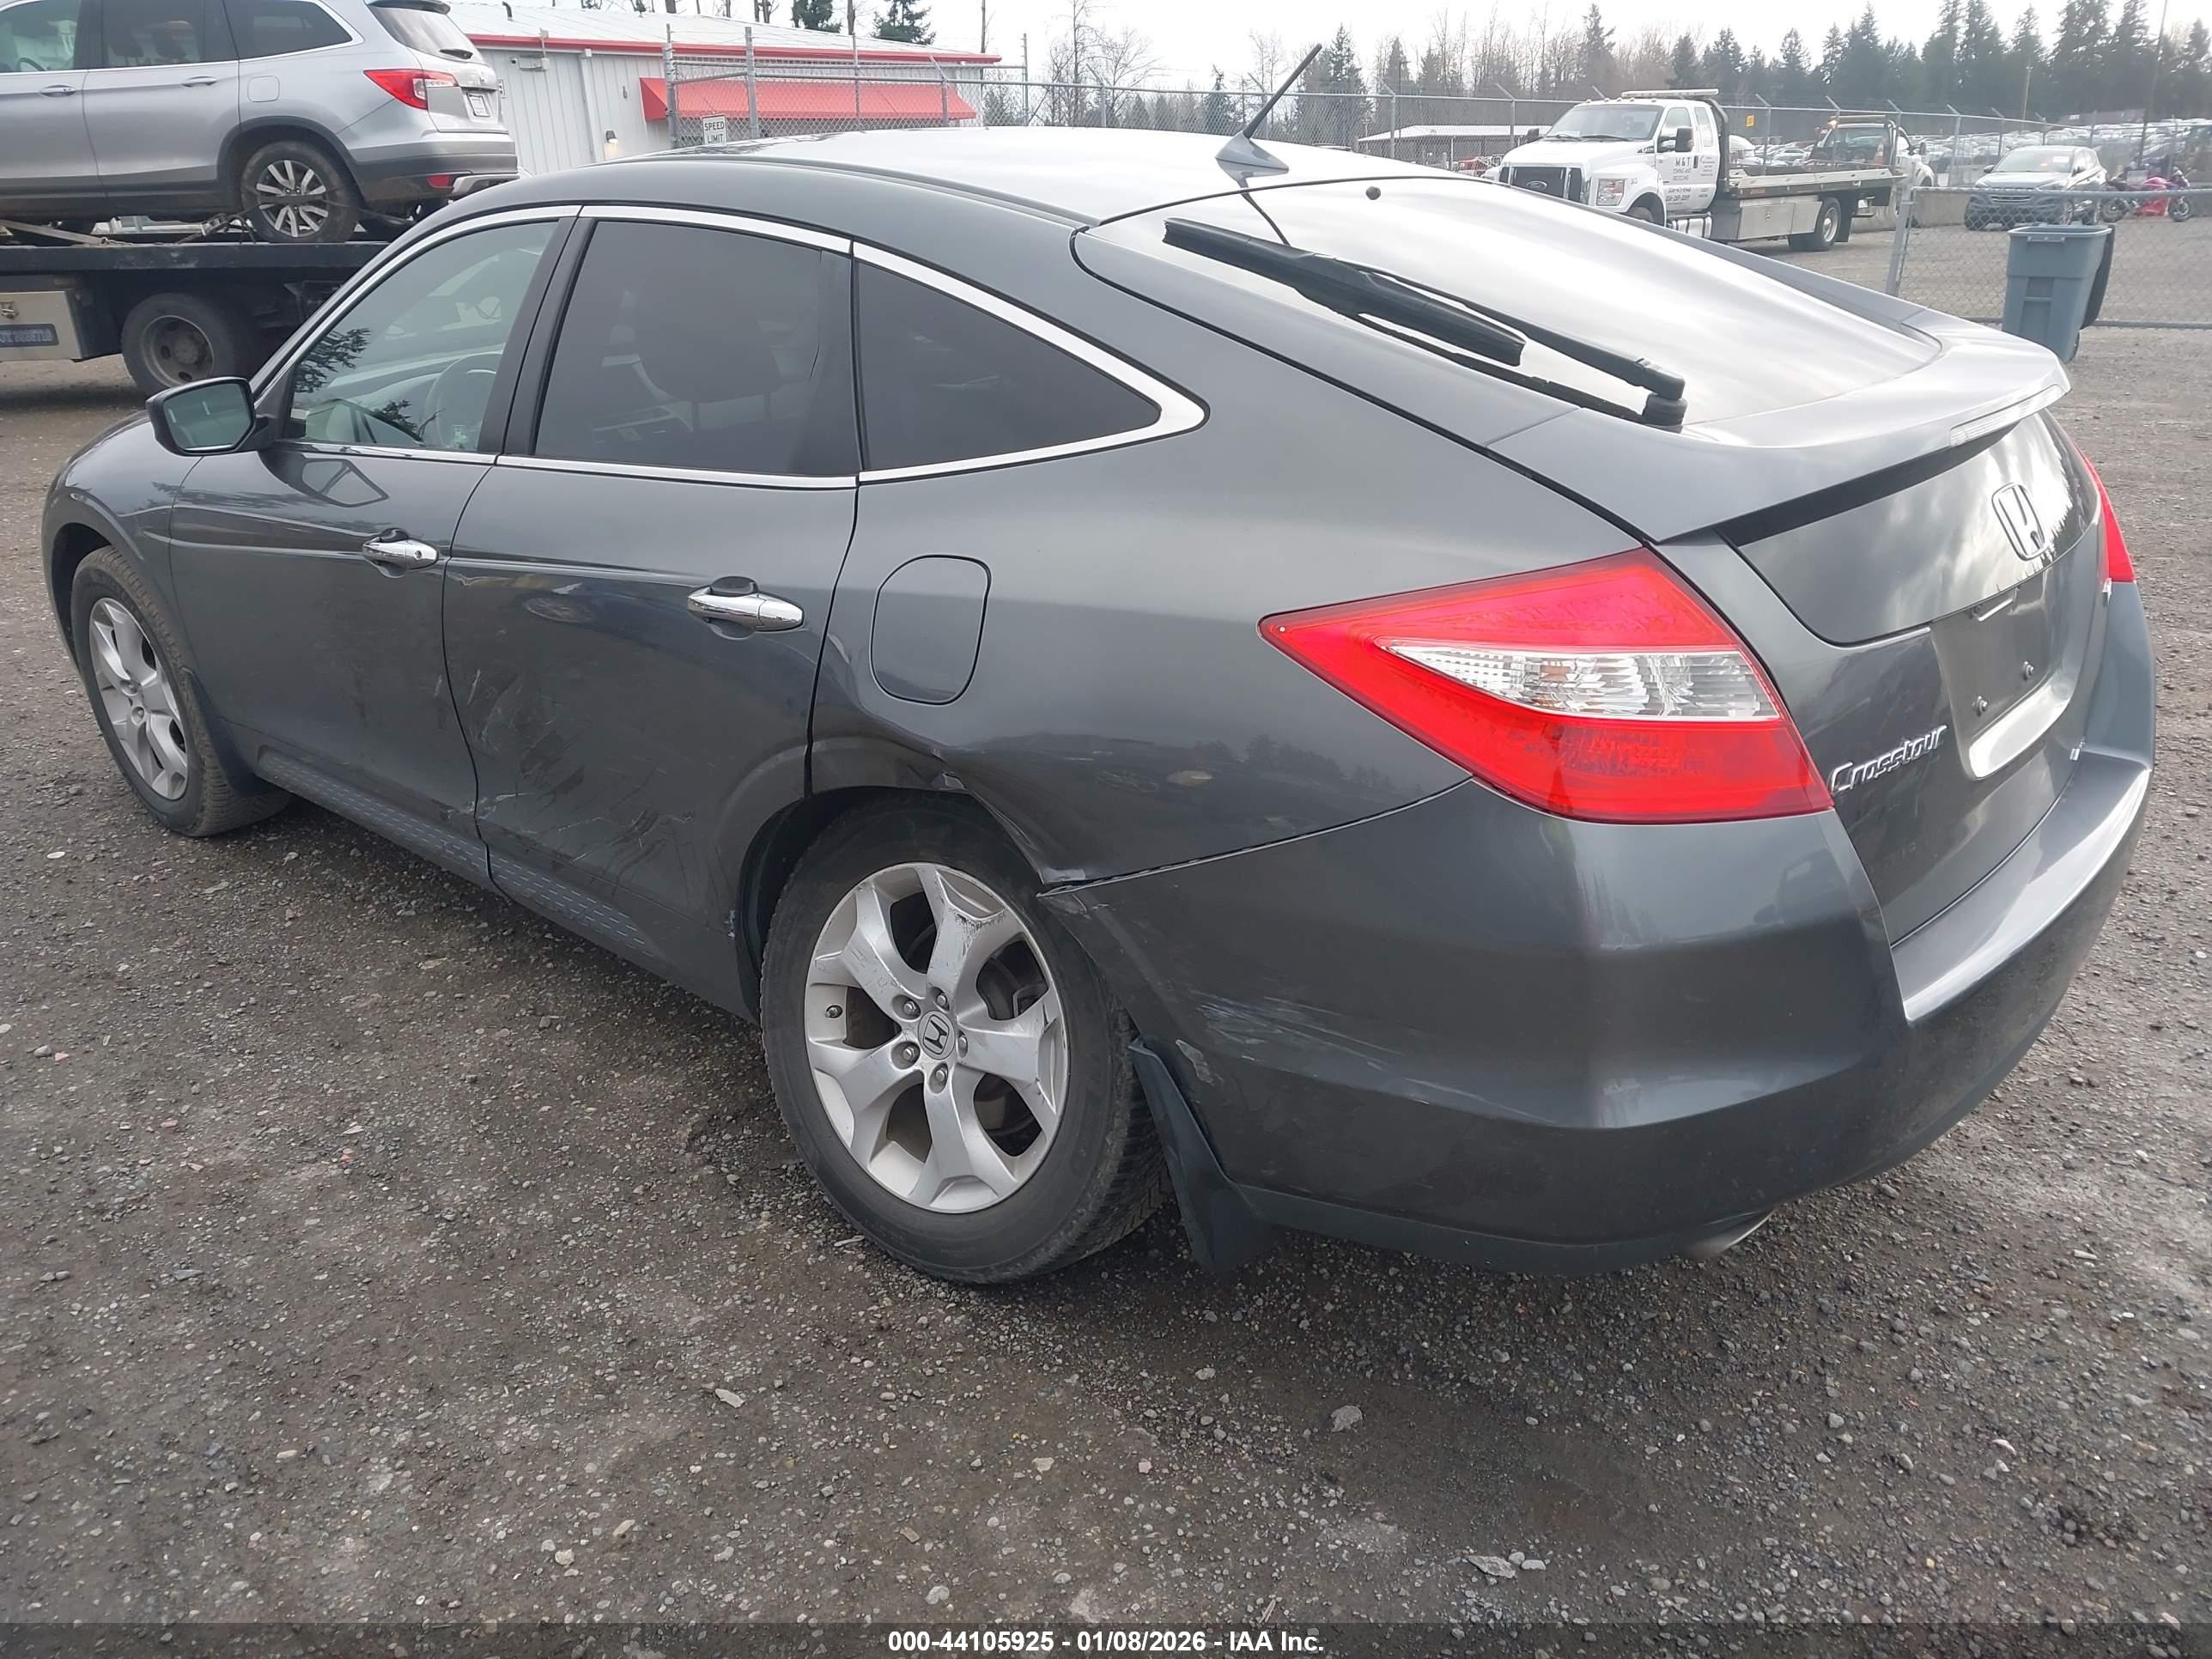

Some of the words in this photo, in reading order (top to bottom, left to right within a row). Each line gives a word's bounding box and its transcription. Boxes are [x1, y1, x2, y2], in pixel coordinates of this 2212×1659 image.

[704, 121, 725, 131] SPEED
[707, 133, 724, 144] LIMIT
[1831, 725, 1948, 794] Crosstour
